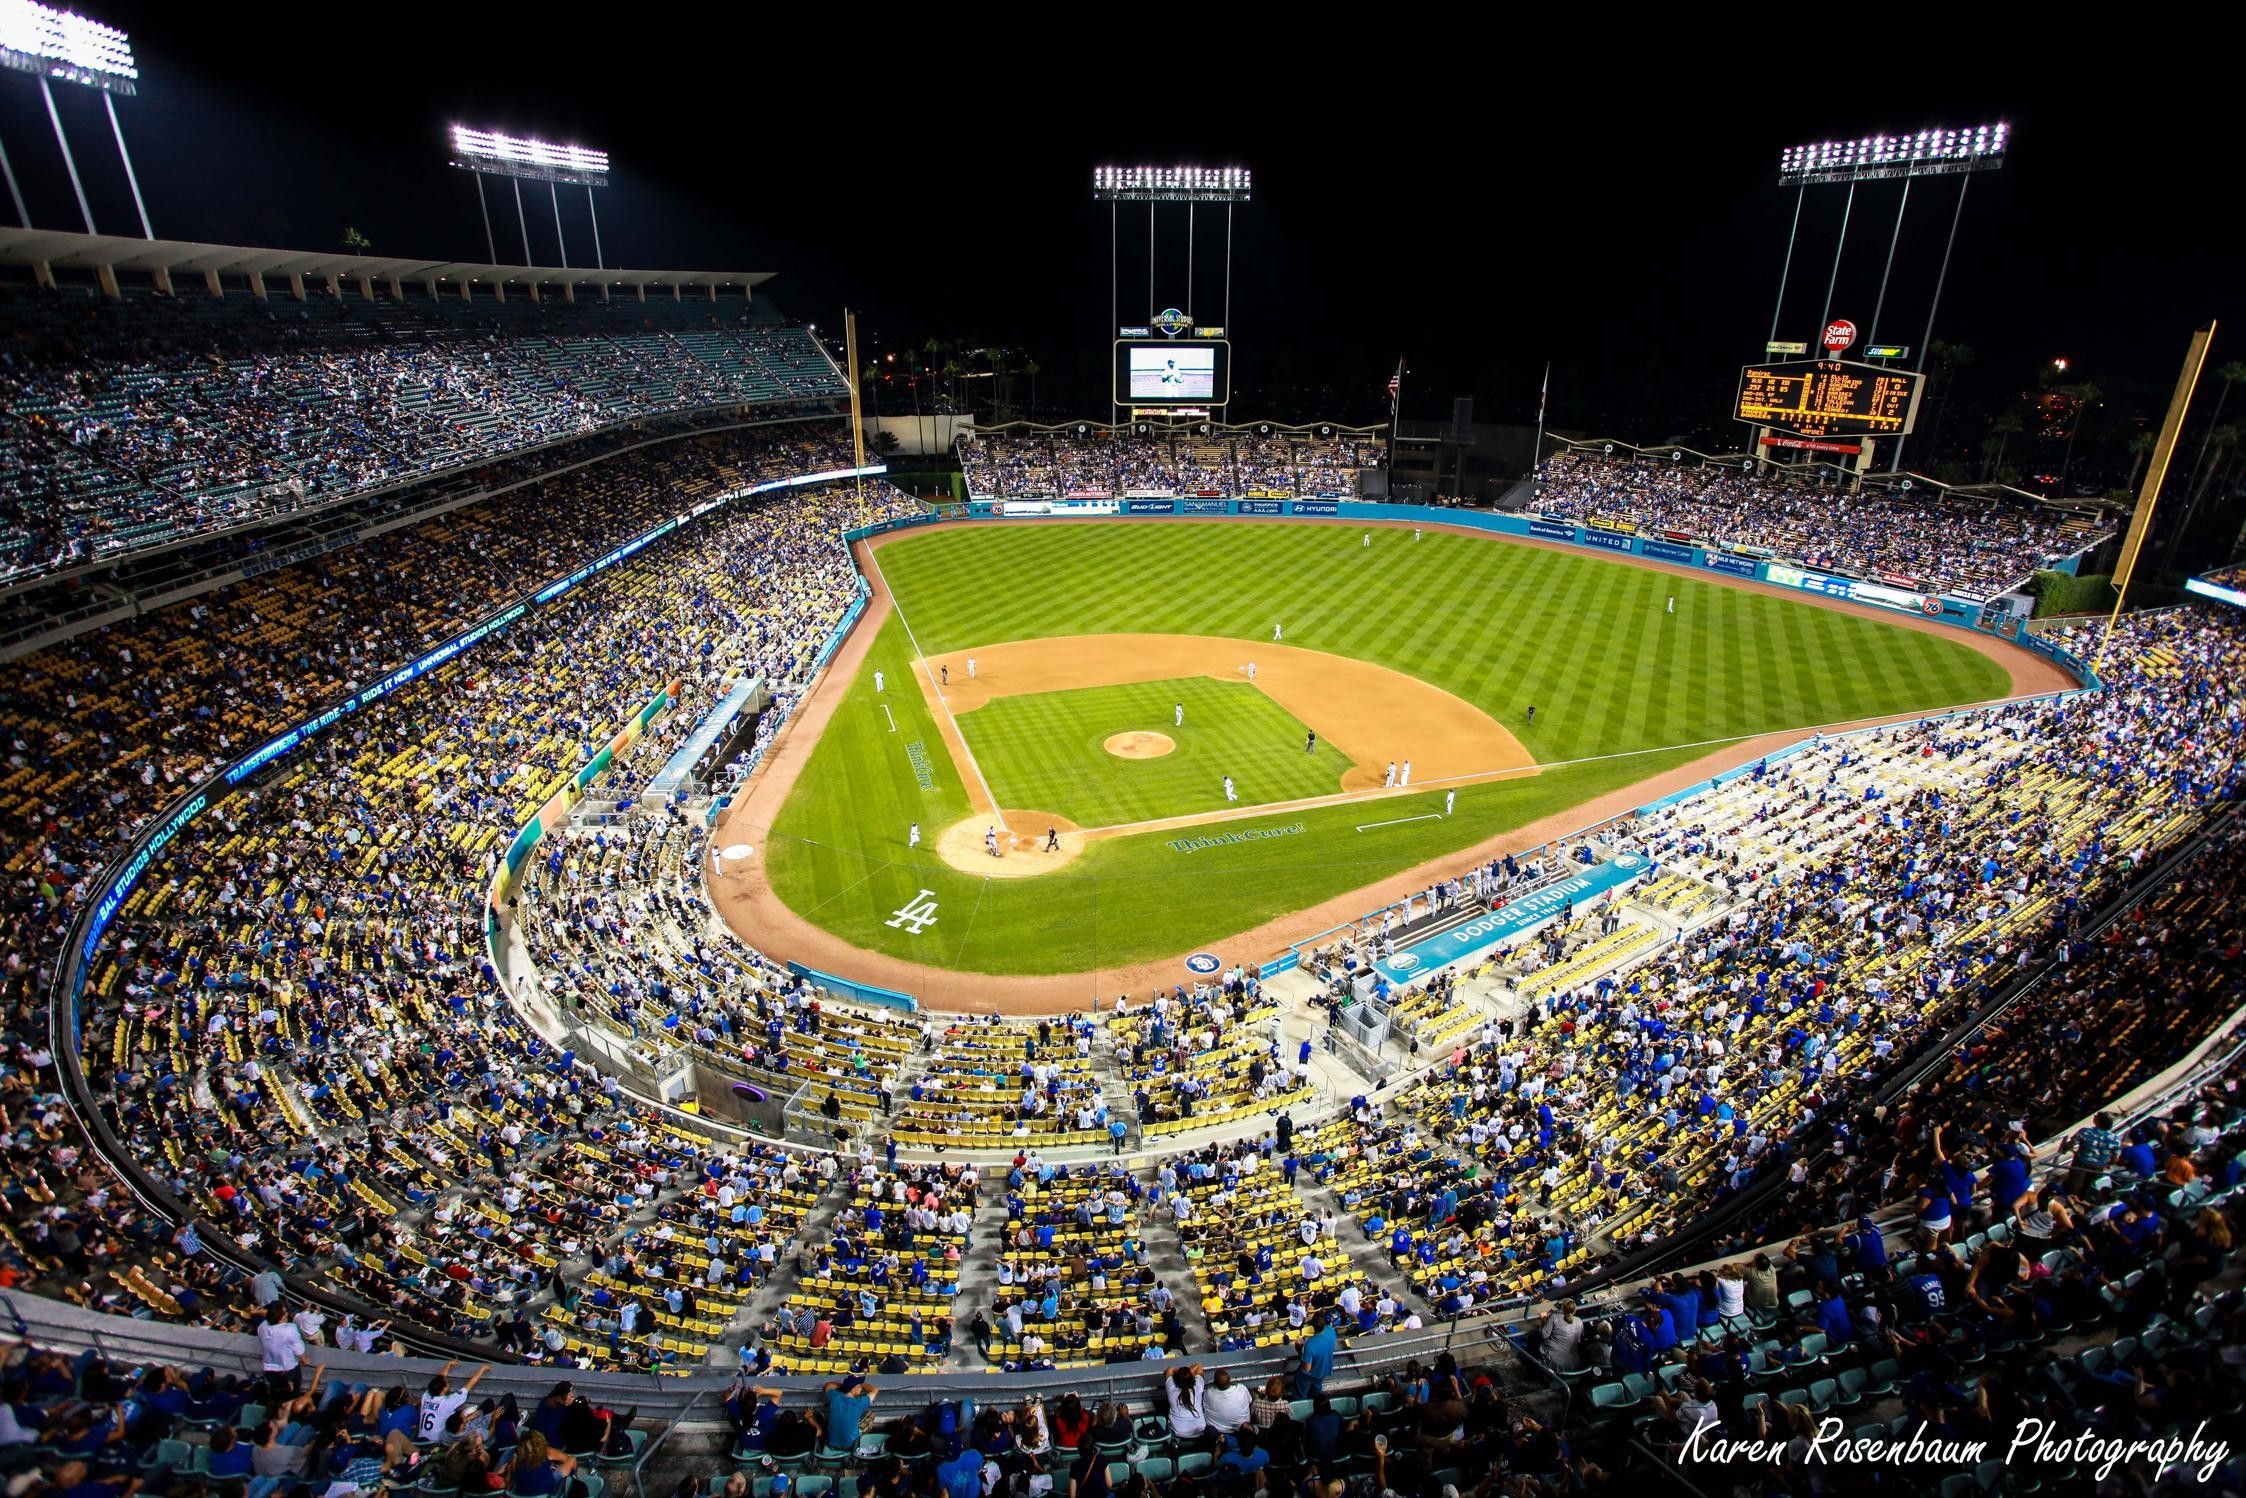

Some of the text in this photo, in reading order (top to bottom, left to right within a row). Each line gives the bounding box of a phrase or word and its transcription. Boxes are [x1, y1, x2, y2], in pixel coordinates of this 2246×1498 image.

[1824, 334, 1849, 345] Farm
[1827, 326, 1851, 336] State
[1818, 362, 1840, 372] 9:40
[1586, 534, 1619, 546] UNITED
[296, 545, 323, 560] CLUB
[1729, 558, 1755, 568] NETWORK
[1927, 602, 1939, 612] 76
[418, 606, 525, 670] UNIVERSAL STUDIOS HOLLYWOOD
[361, 667, 414, 703] RIDE IT NOW
[301, 722, 319, 736] THE
[319, 699, 356, 726] RIDE-3D
[115, 850, 149, 898] STUDIOS
[149, 794, 206, 855] HOLLYWOOD
[884, 889, 939, 934] LA
[1452, 878, 1592, 942] DODGER STADIUM
[1516, 905, 1559, 926] SINCE 1962
[1928, 1290, 1944, 1307] 99
[421, 1413, 436, 1431] 16
